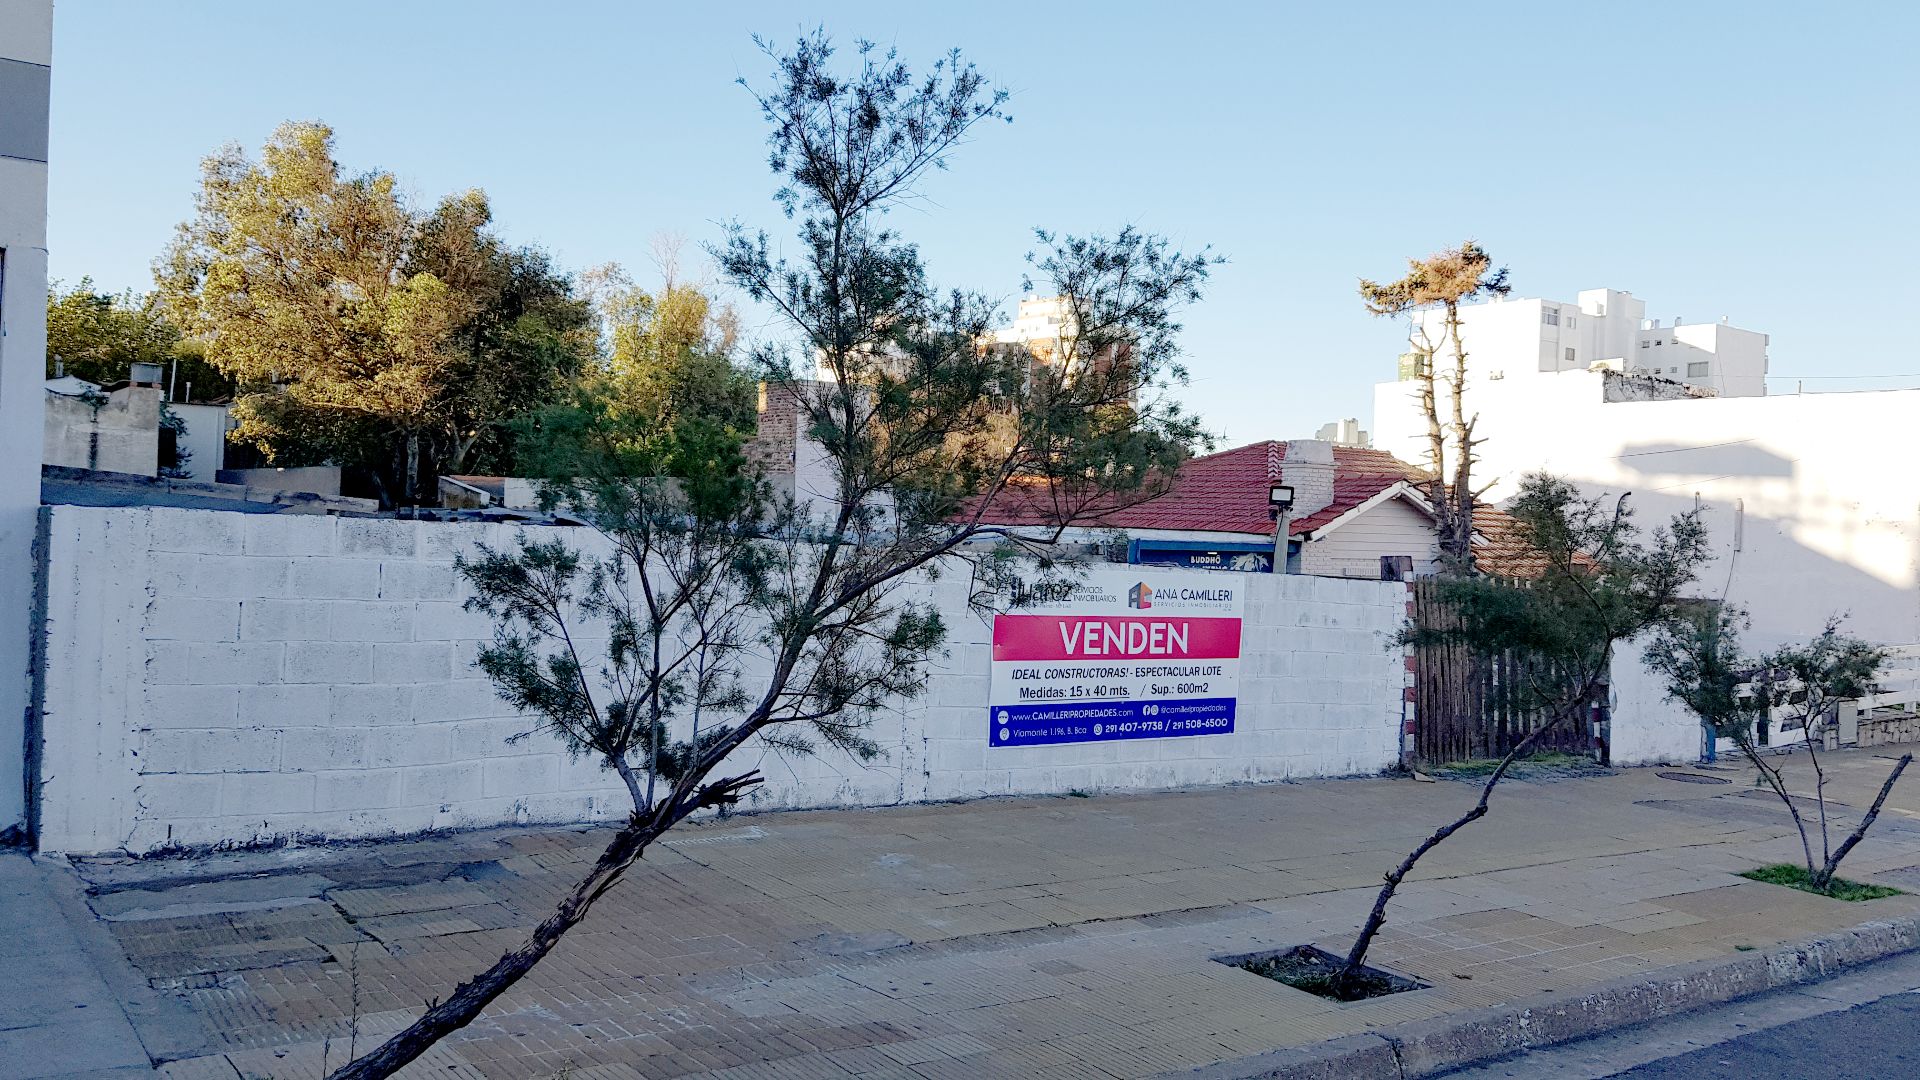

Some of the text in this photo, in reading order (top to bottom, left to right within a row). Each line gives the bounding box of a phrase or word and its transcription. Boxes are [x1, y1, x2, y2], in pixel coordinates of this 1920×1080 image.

[1155, 588, 1233, 602] ANA CAMILLERI
[1059, 621, 1189, 655] VENDEN
[1011, 668, 1042, 680] IDEAL
[1135, 666, 1200, 678] ESPECTACULAR
[1202, 665, 1222, 676] LOTE
[1019, 682, 1209, 699] Medidas: 15 x 40 mts. / Sup.: 600m2
[1011, 708, 1134, 721] www.CAMILLERIPROPIEDADES.com
[1013, 728, 1048, 738] Viamonte
[1105, 718, 1228, 733] 291 407-9738 / 291 508-6500
